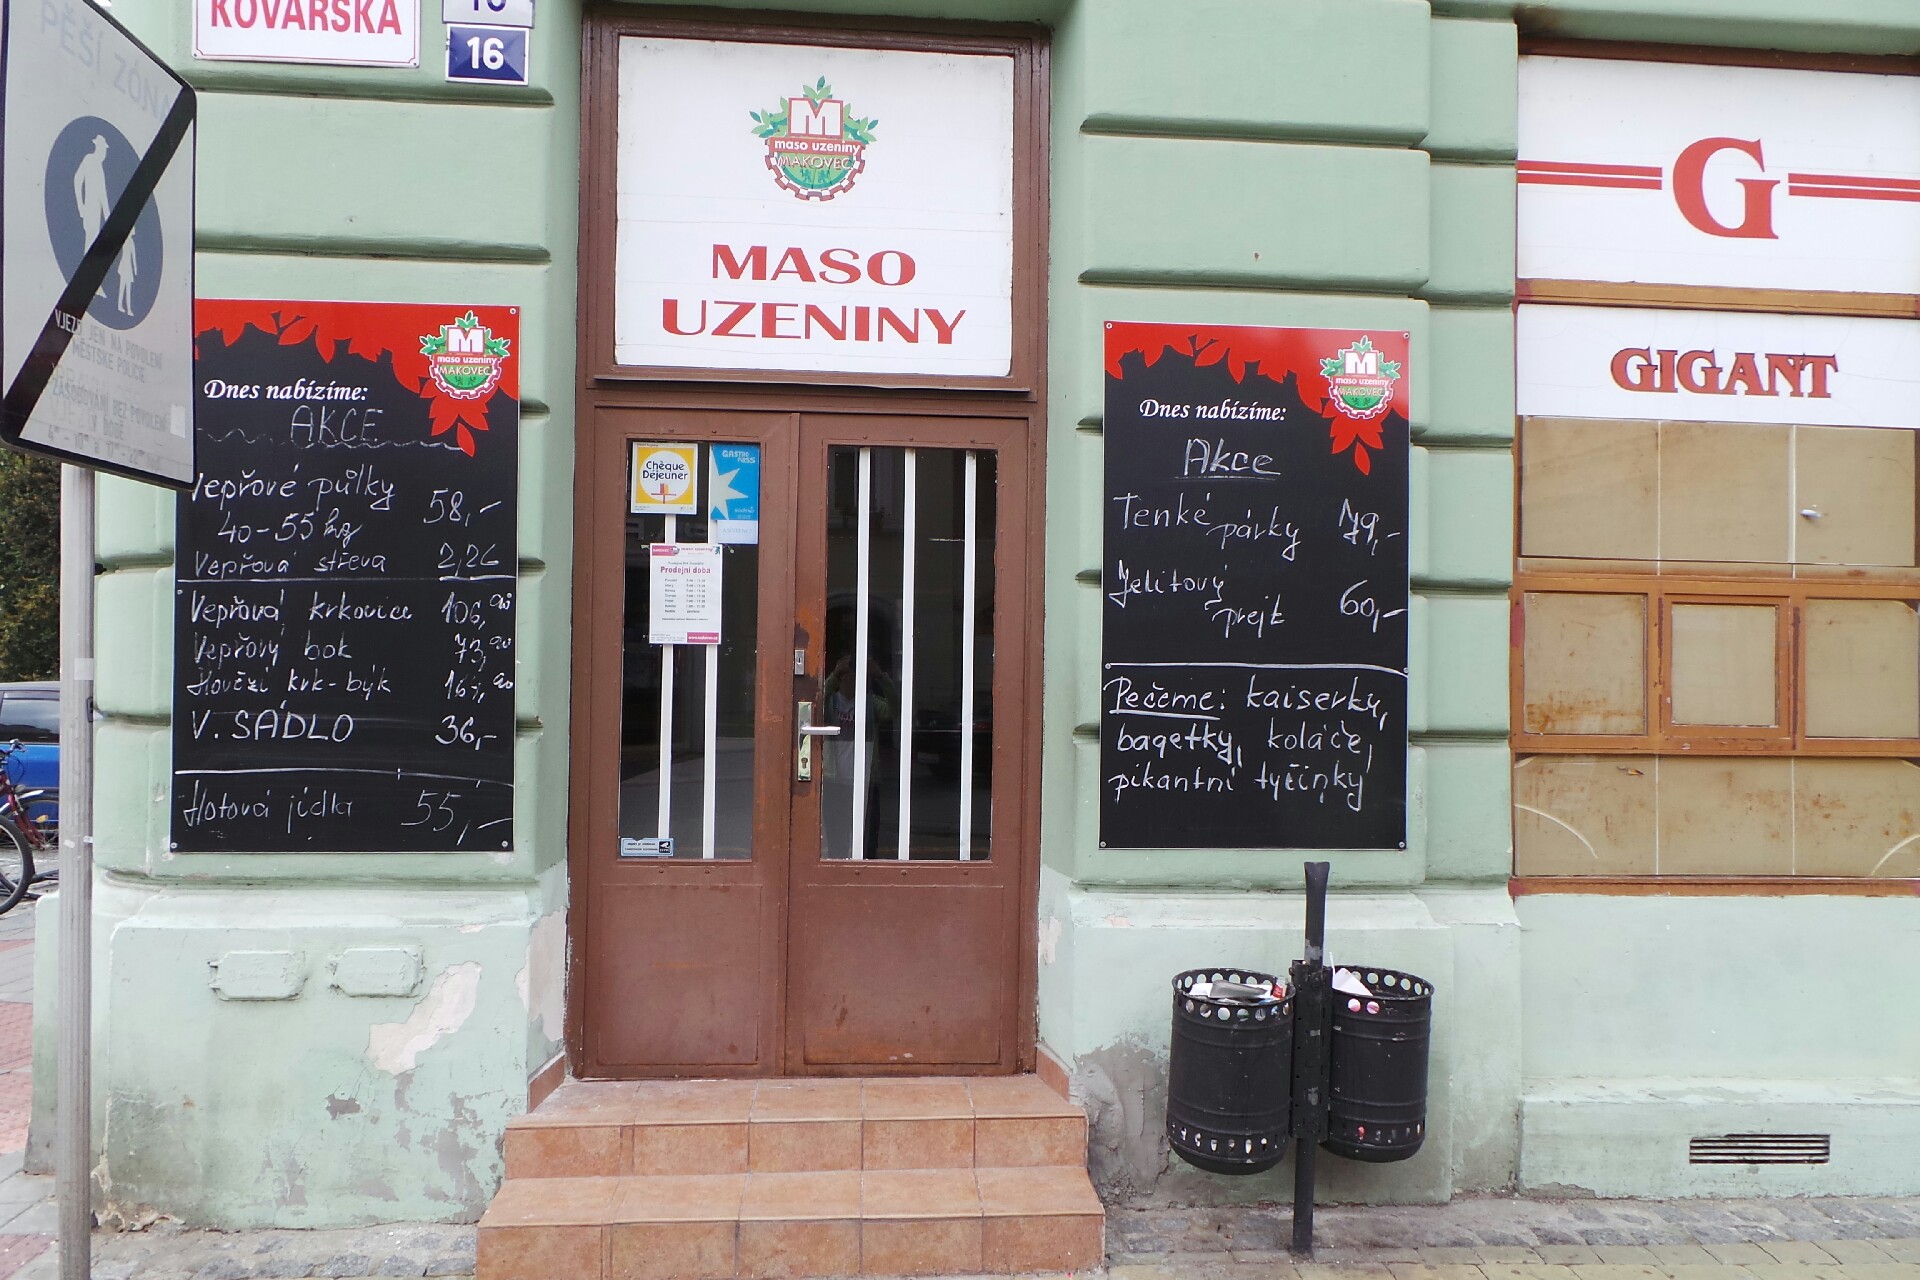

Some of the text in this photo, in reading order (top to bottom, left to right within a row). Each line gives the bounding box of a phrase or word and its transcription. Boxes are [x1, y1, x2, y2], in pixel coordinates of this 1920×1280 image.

[467, 36, 505, 70] 16
[774, 140, 861, 155] maso uzeniny
[776, 155, 853, 170] MAKOVEC
[1672, 136, 1781, 240] G
[712, 243, 916, 286] MASO
[662, 298, 967, 345] UZENINY
[439, 366, 492, 376] MAKOVEC
[462, 354, 498, 366] uzeniny
[1610, 346, 1839, 399] GIGANT
[203, 378, 369, 401] Dnes nabízíme:
[1358, 376, 1390, 387] uzeniny
[1139, 397, 1289, 422] Dnes nabízíme:
[290, 404, 384, 444] AKCE
[645, 460, 685, 472] Chèque
[1183, 436, 1282, 477] Akce
[642, 469, 689, 481] Déjeuner
[1112, 491, 1212, 531] Tenké
[1206, 505, 1302, 562] párky
[692, 566, 711, 574] doba
[303, 629, 353, 661] bok
[231, 700, 355, 743] SÁDLO
